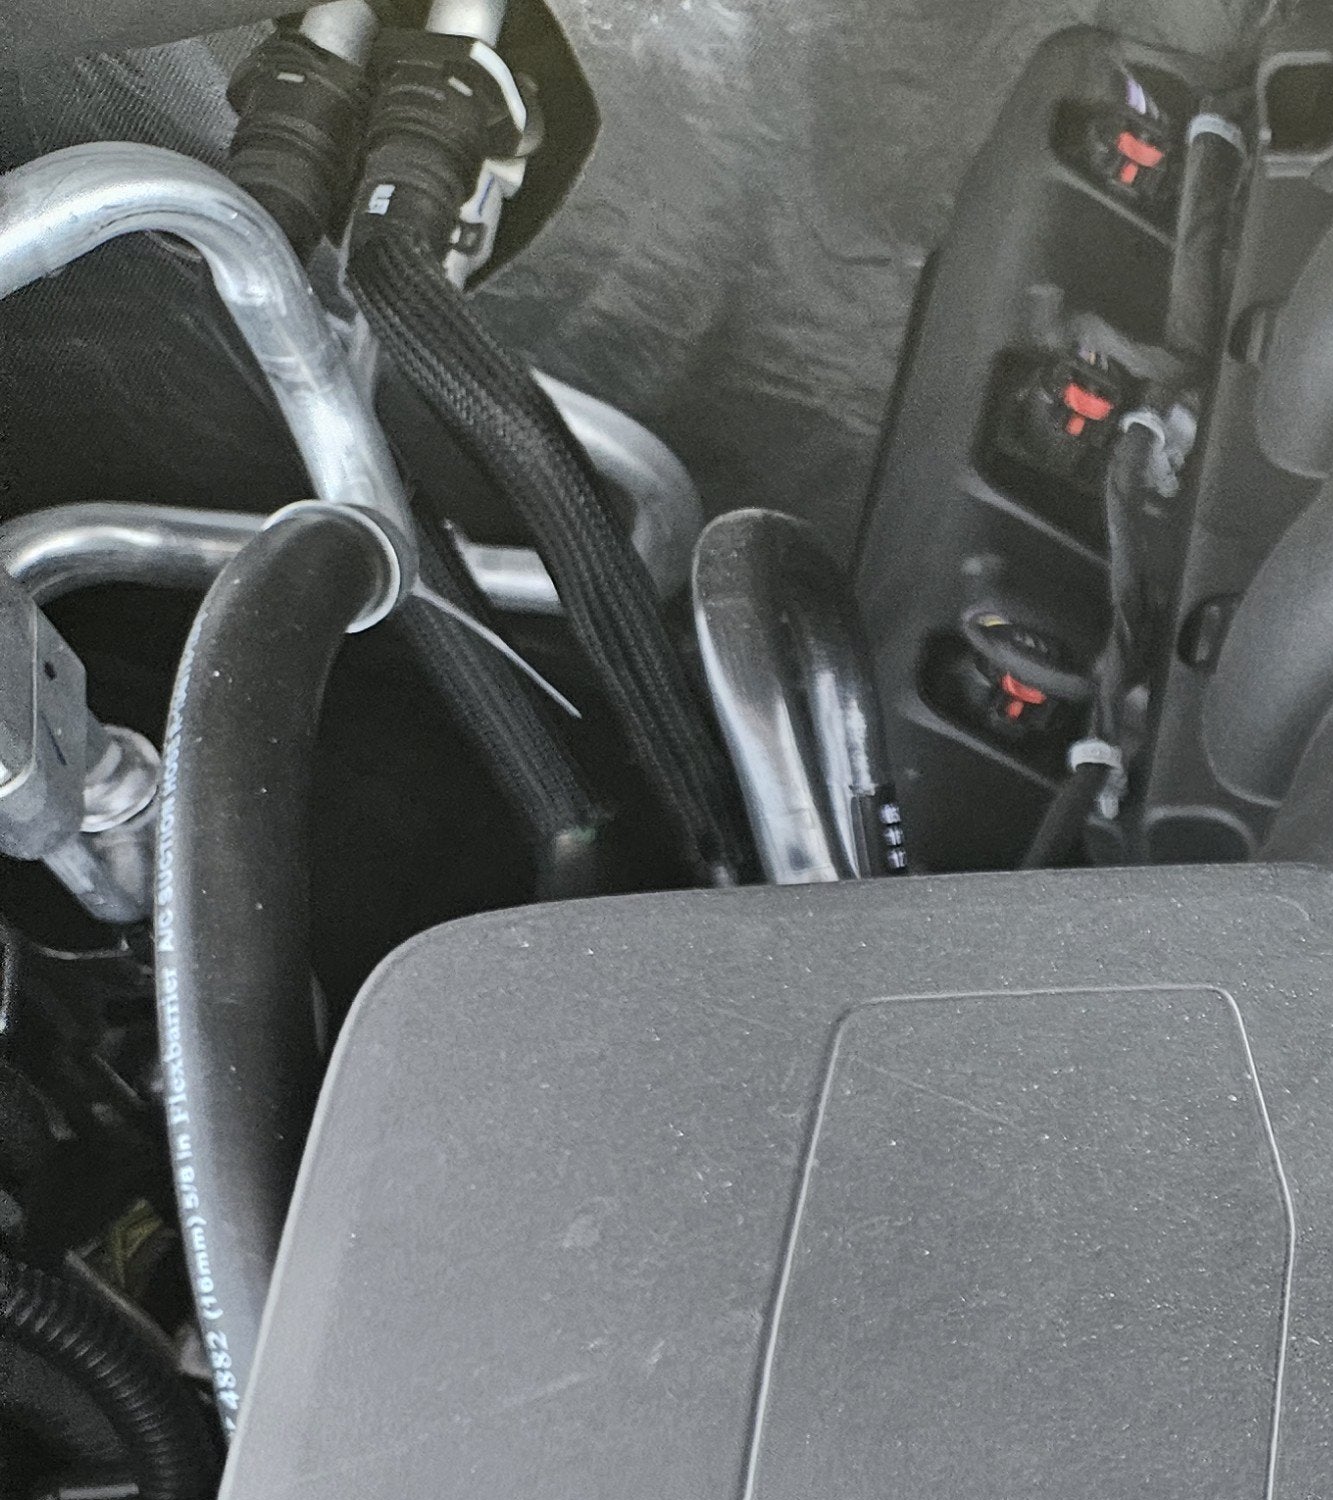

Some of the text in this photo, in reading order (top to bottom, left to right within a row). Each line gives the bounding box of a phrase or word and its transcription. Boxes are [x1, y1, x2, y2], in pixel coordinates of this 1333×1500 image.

[158, 908, 174, 951] A/C
[161, 967, 190, 1125] Flexbarrier
[179, 1165, 200, 1210] 5/8
[186, 1215, 224, 1320] (16mm)
[206, 1330, 240, 1410] 4882
